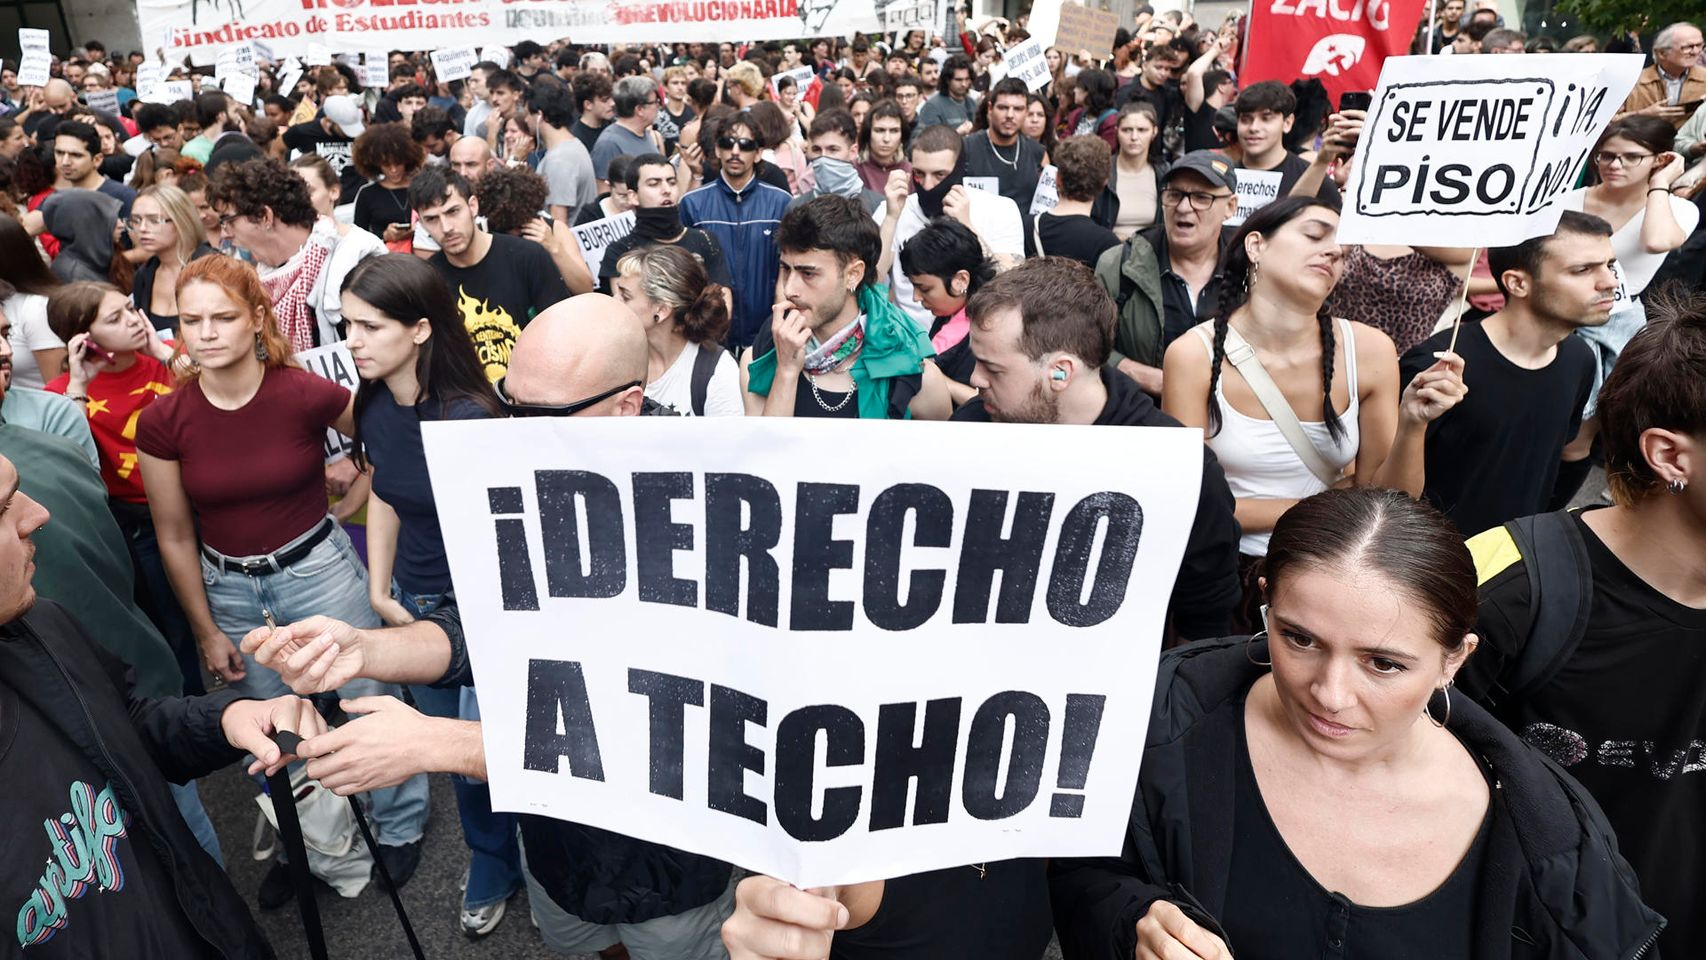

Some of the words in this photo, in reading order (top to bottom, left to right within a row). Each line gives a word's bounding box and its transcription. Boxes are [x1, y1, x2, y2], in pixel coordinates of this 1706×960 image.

[174, 20, 300, 47] Sindicato
[306, 15, 328, 34] de
[335, 10, 490, 32] Estudiantes
[1387, 100, 1432, 142] SE
[1438, 99, 1534, 141] VENDE
[1236, 180, 1277, 198] erechos
[1529, 149, 1588, 208] NO!
[578, 216, 635, 251] BURBUJA
[488, 470, 1143, 632] ¡DERECHO
[524, 659, 605, 782] A
[628, 668, 1106, 841] TECHO!
